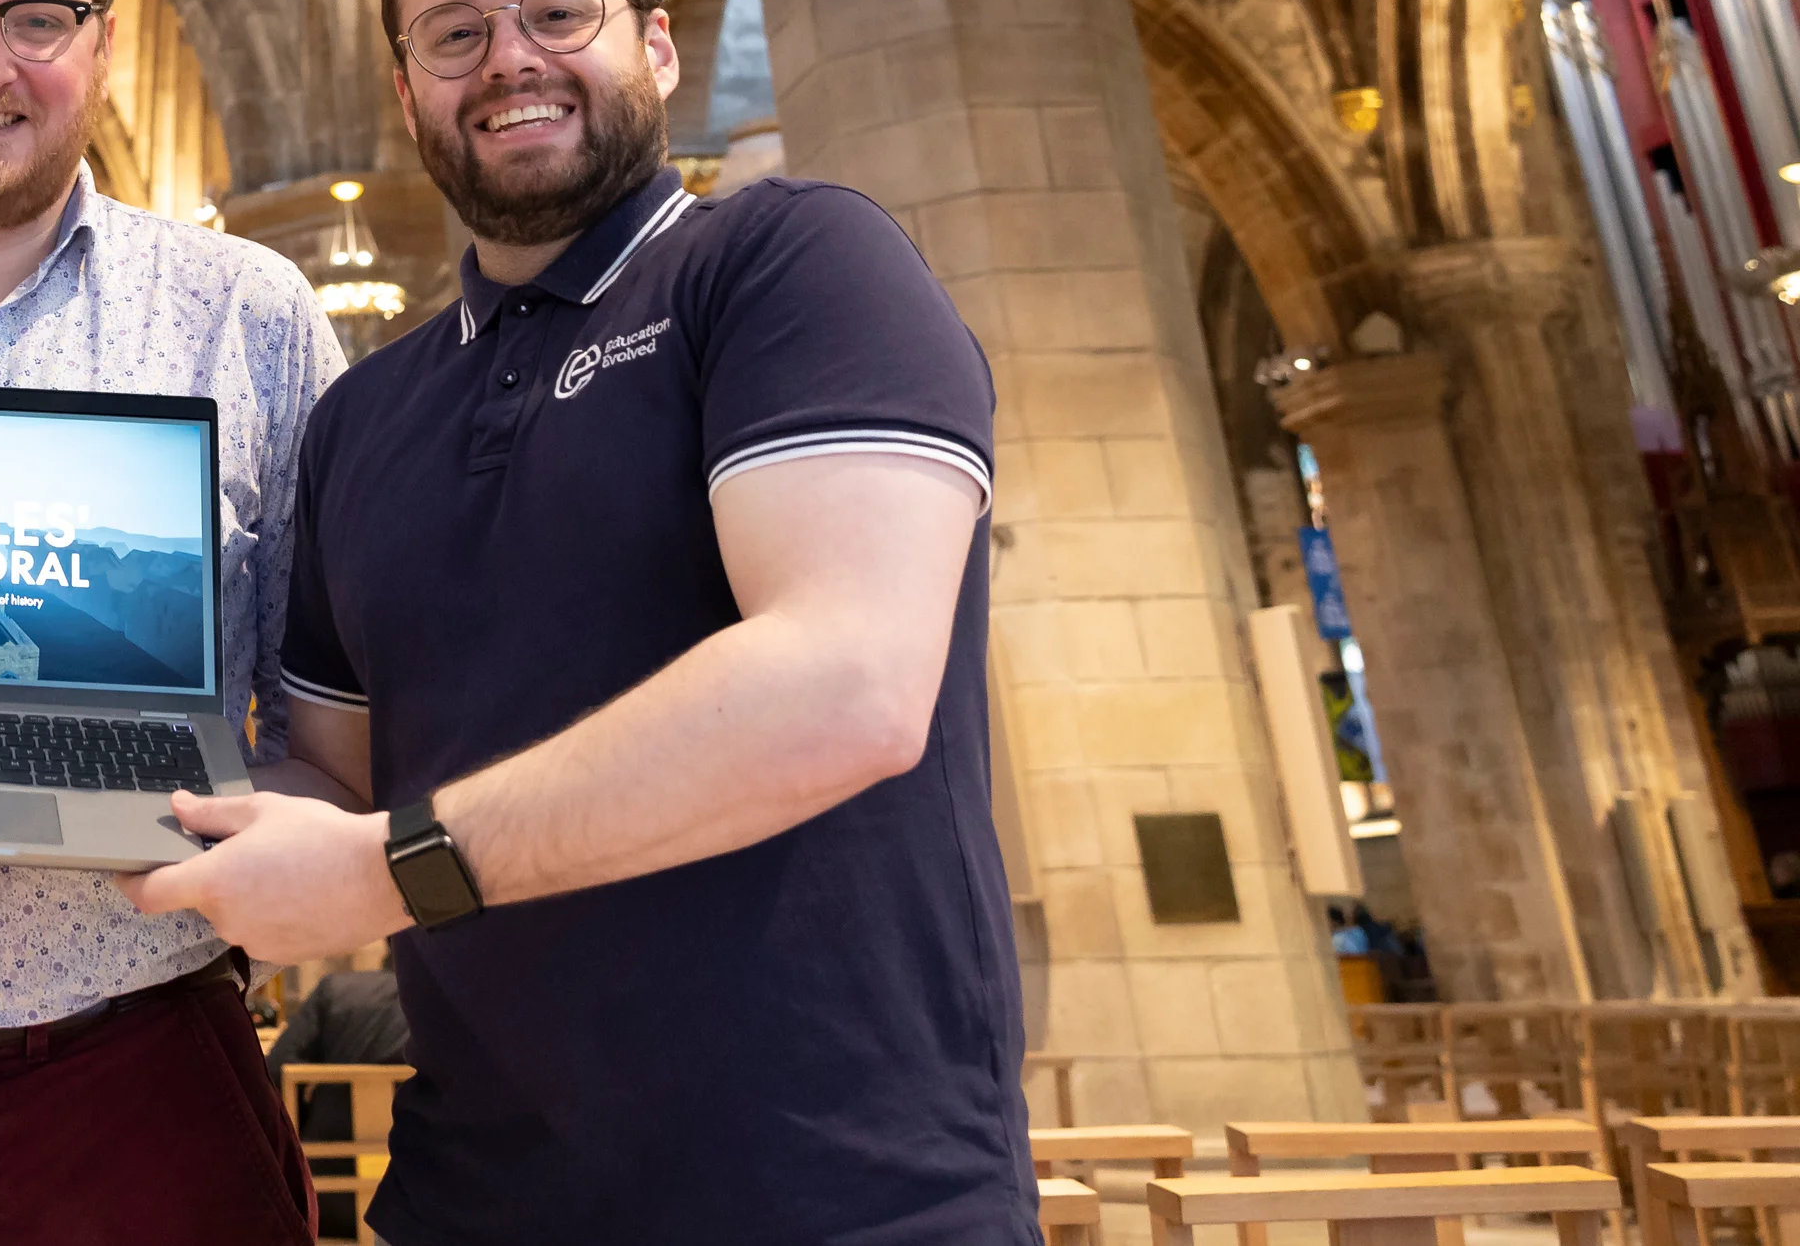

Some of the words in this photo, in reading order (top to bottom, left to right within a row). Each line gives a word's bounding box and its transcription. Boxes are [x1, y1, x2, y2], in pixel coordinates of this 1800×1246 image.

[605, 318, 671, 353] Education
[602, 339, 657, 368] Evolved
[11, 594, 44, 609] history
